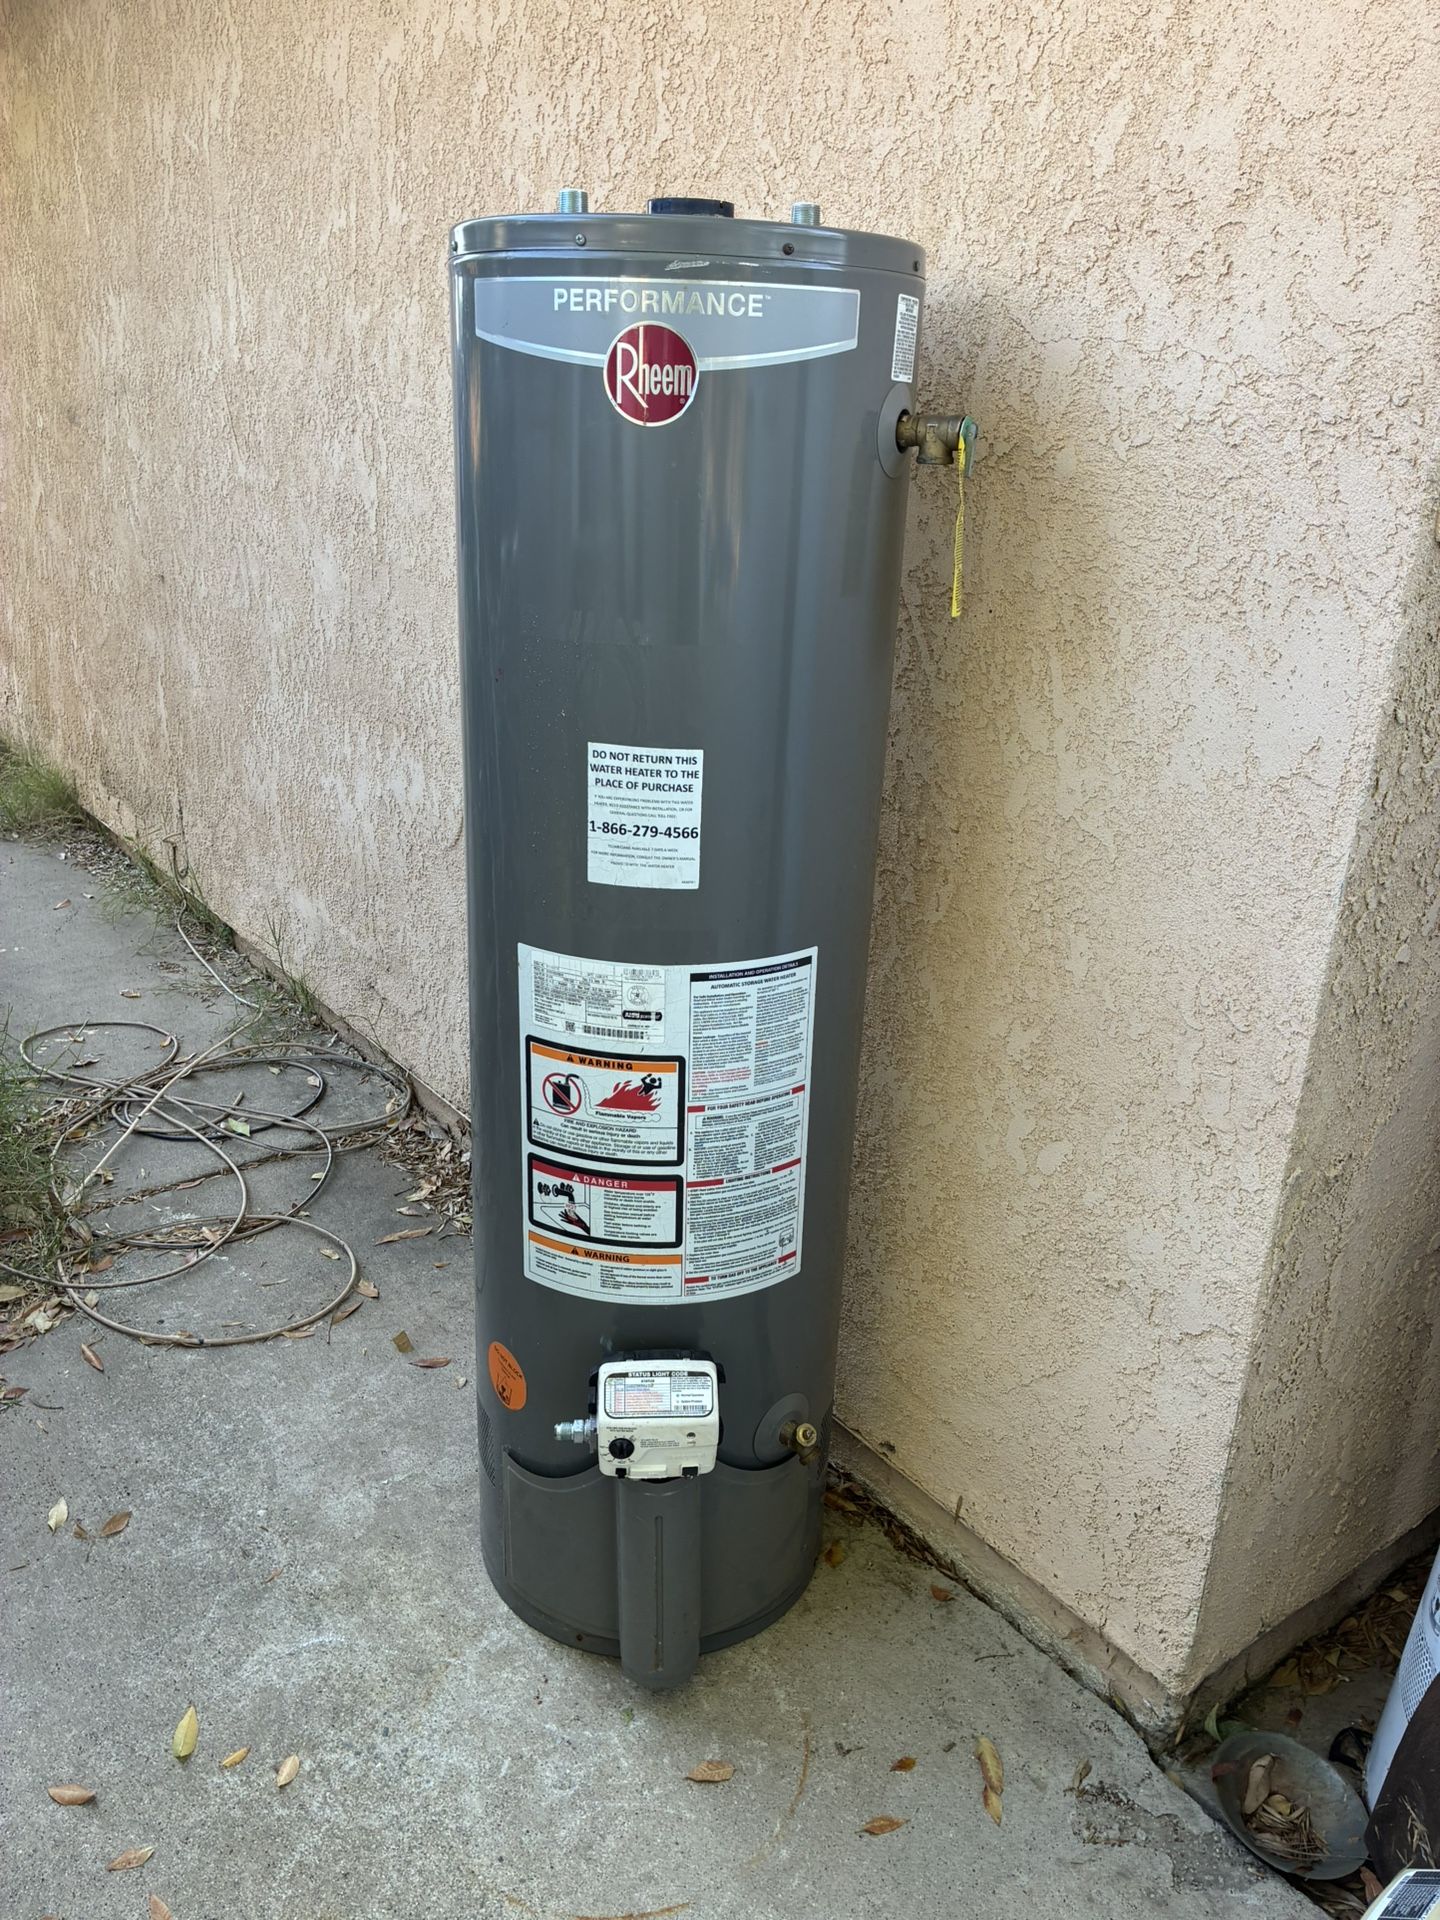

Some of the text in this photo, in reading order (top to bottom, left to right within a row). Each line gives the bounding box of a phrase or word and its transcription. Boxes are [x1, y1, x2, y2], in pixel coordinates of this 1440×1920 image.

[616, 326, 692, 408] Rheem
[592, 750, 697, 765] DO NOT RETURN THIS
[590, 764, 699, 779] WATER HEATER TO THE
[595, 778, 623, 788] PLACE
[642, 782, 694, 792] PURCHASE
[590, 821, 698, 839] 1-866-279-4566
[756, 966, 781, 974] OPERATION
[782, 962, 798, 970] DETAILS
[711, 981, 740, 989] AUTOMATIC
[780, 972, 796, 980] HEATER
[579, 1057, 633, 1070] WARNING
[756, 1097, 770, 1105] BEFORE
[595, 1111, 625, 1119] Flammable
[587, 1122, 614, 1131] EXPLOSION
[606, 1130, 619, 1138] injury
[745, 1170, 771, 1180] INSTRUCTIONS
[584, 1177, 628, 1188] DANGER
[584, 1250, 630, 1263] WARNING
[758, 1261, 777, 1270] APPLIANCE
